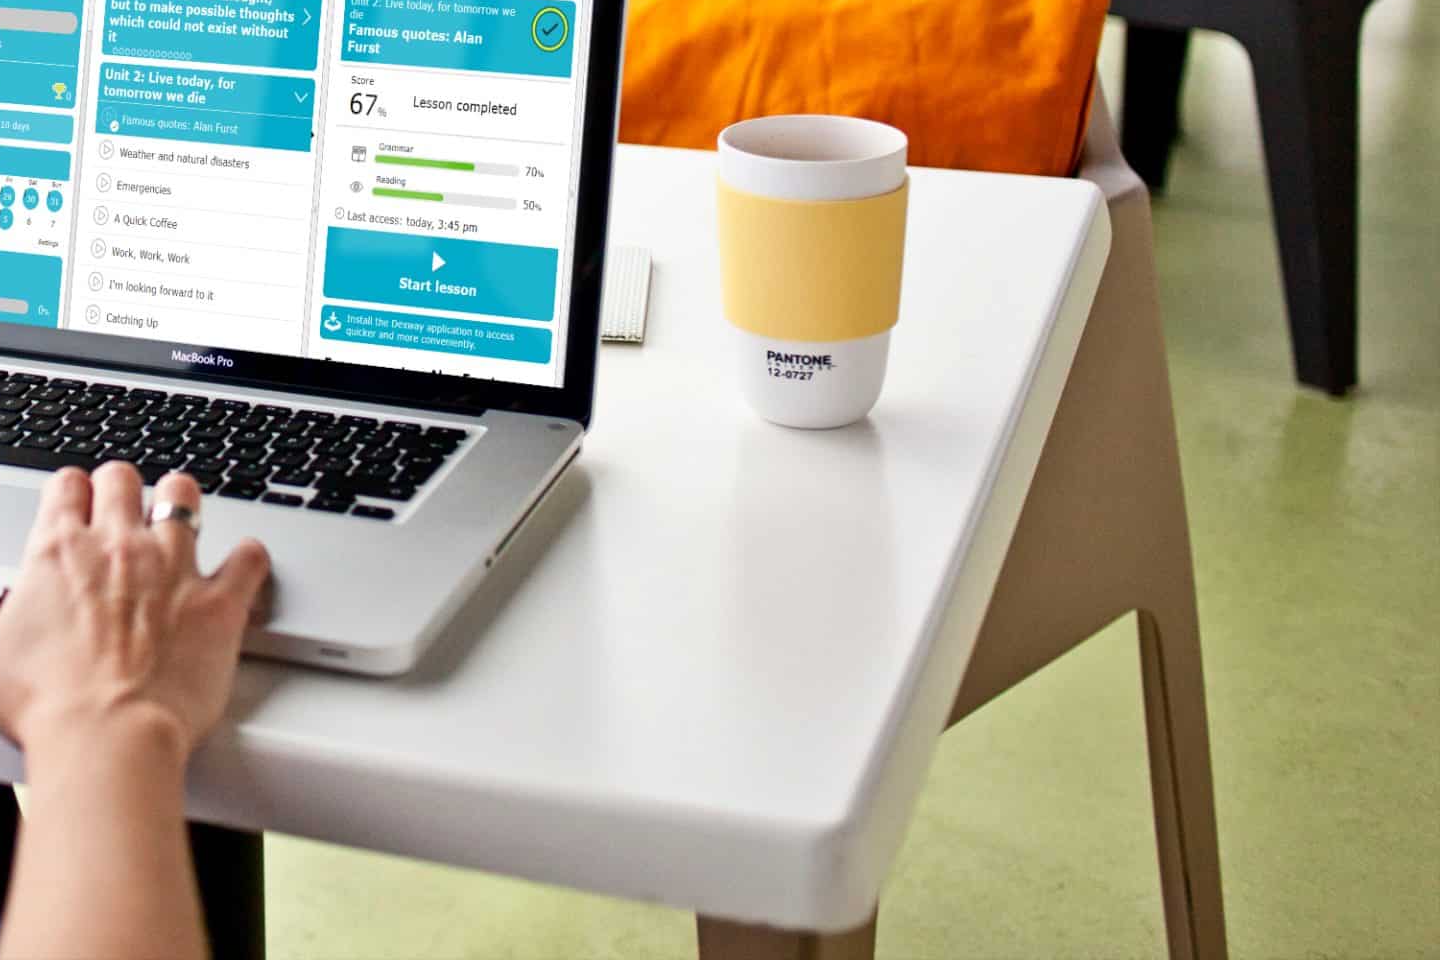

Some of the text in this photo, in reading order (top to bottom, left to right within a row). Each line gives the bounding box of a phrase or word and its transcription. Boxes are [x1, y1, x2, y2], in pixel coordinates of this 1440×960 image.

[134, 0, 147, 12] to
[150, 1, 183, 15] make
[186, 3, 236, 22] possible
[239, 6, 295, 25] thoughts
[349, 8, 364, 20] die
[406, 0, 435, 13] today,
[437, 1, 451, 13] for
[453, 3, 499, 16] tomorrow
[502, 7, 516, 17] we
[109, 15, 289, 39] which could not exist without
[348, 23, 483, 46] Famous quotes: Alan
[108, 30, 117, 43] it
[347, 40, 380, 54] Furst
[105, 68, 236, 91] Unit 2: Live today, for
[351, 75, 375, 86] Score
[104, 85, 207, 104] tomorrow we die
[413, 95, 453, 111] Lesson
[456, 99, 518, 121] completed
[193, 119, 213, 132] Alan
[216, 121, 238, 135] Furst
[120, 146, 250, 170] Weather and natural disasters
[116, 180, 172, 196] Emergencies
[114, 213, 178, 230] A Quick Coffee
[347, 210, 478, 234] Last access: today, 3:45 pm
[111, 246, 136, 260] Work,
[168, 251, 190, 265] Work
[109, 278, 214, 301] I'm looking forward to it
[399, 276, 477, 297] Start lesson
[106, 312, 159, 329] Catching Up
[347, 314, 514, 342] Install the Dexway application to access
[346, 326, 376, 340] quicker
[379, 330, 394, 341] and
[396, 333, 419, 344] more
[171, 350, 234, 368] MacBook Pro
[767, 350, 832, 366] PANTONE
[767, 367, 814, 381] 12-0727
